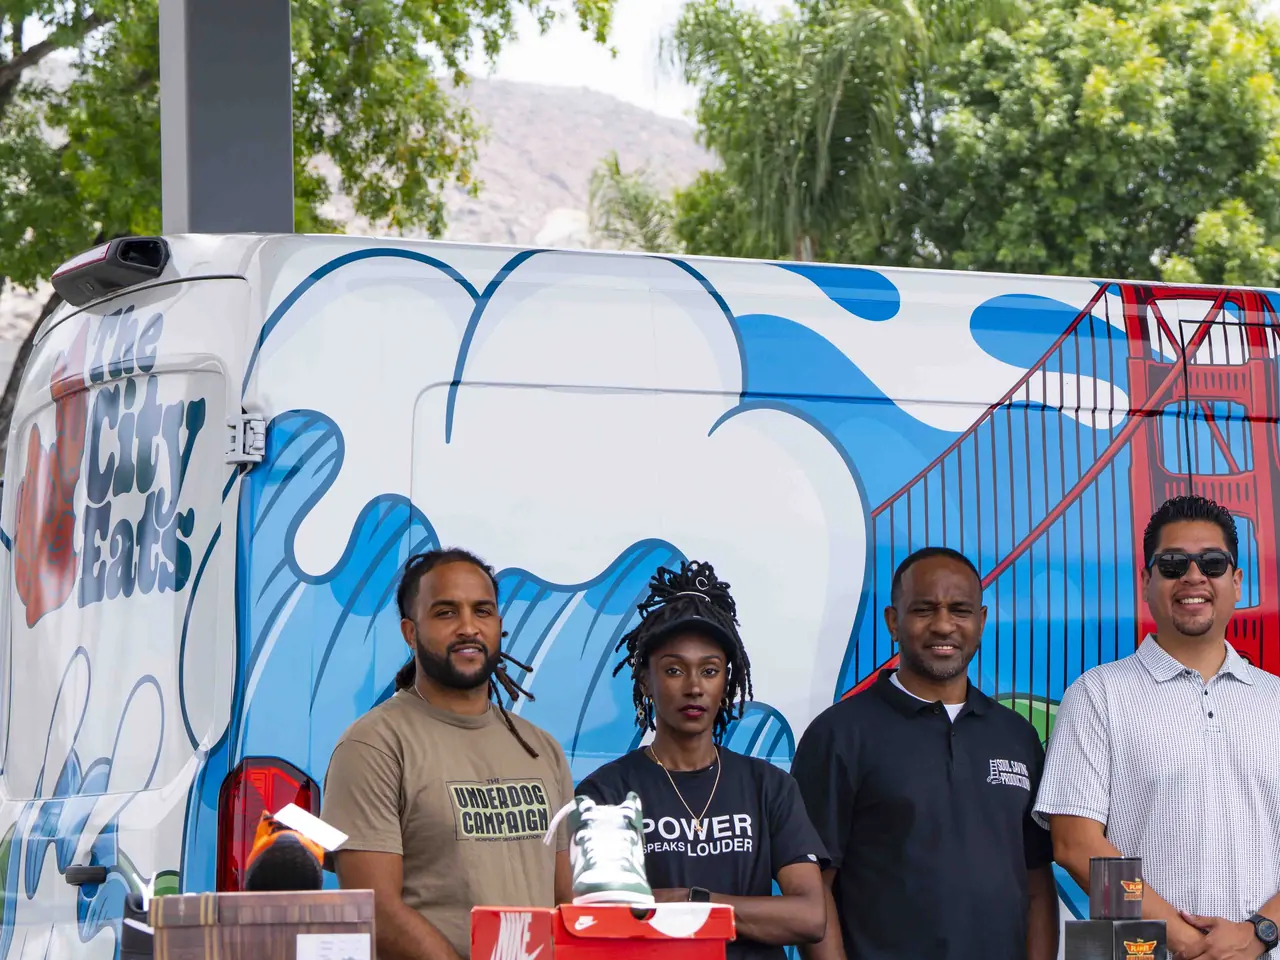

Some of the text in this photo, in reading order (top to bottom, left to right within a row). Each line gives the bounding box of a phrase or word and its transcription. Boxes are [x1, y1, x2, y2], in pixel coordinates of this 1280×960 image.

[89, 304, 164, 384] The
[85, 375, 206, 529] City
[77, 490, 196, 609] Eats
[485, 777, 500, 785] THE
[453, 784, 546, 810] UNDERDOG
[461, 808, 549, 835] CAMPAIGN
[642, 813, 753, 841] POWER
[687, 837, 753, 857] LOUDER
